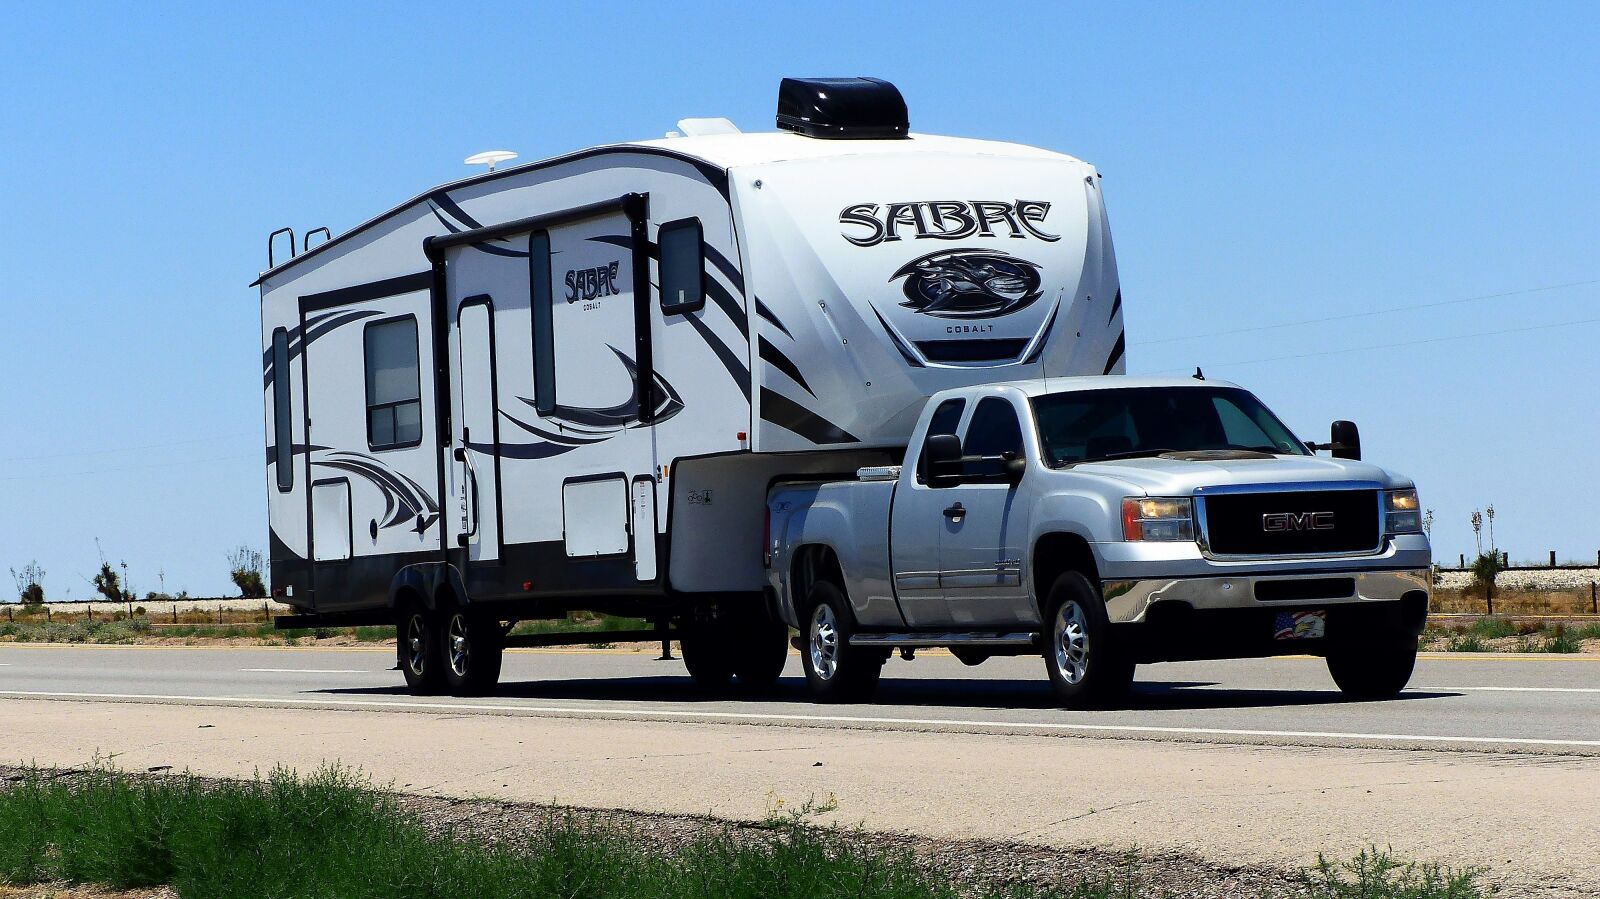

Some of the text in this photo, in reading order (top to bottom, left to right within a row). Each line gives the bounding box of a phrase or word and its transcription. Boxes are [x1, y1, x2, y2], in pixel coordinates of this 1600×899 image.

[839, 199, 1062, 247] SABRE
[565, 260, 620, 304] SABRE
[946, 325, 993, 333] COBALT
[1262, 511, 1334, 532] GMC
